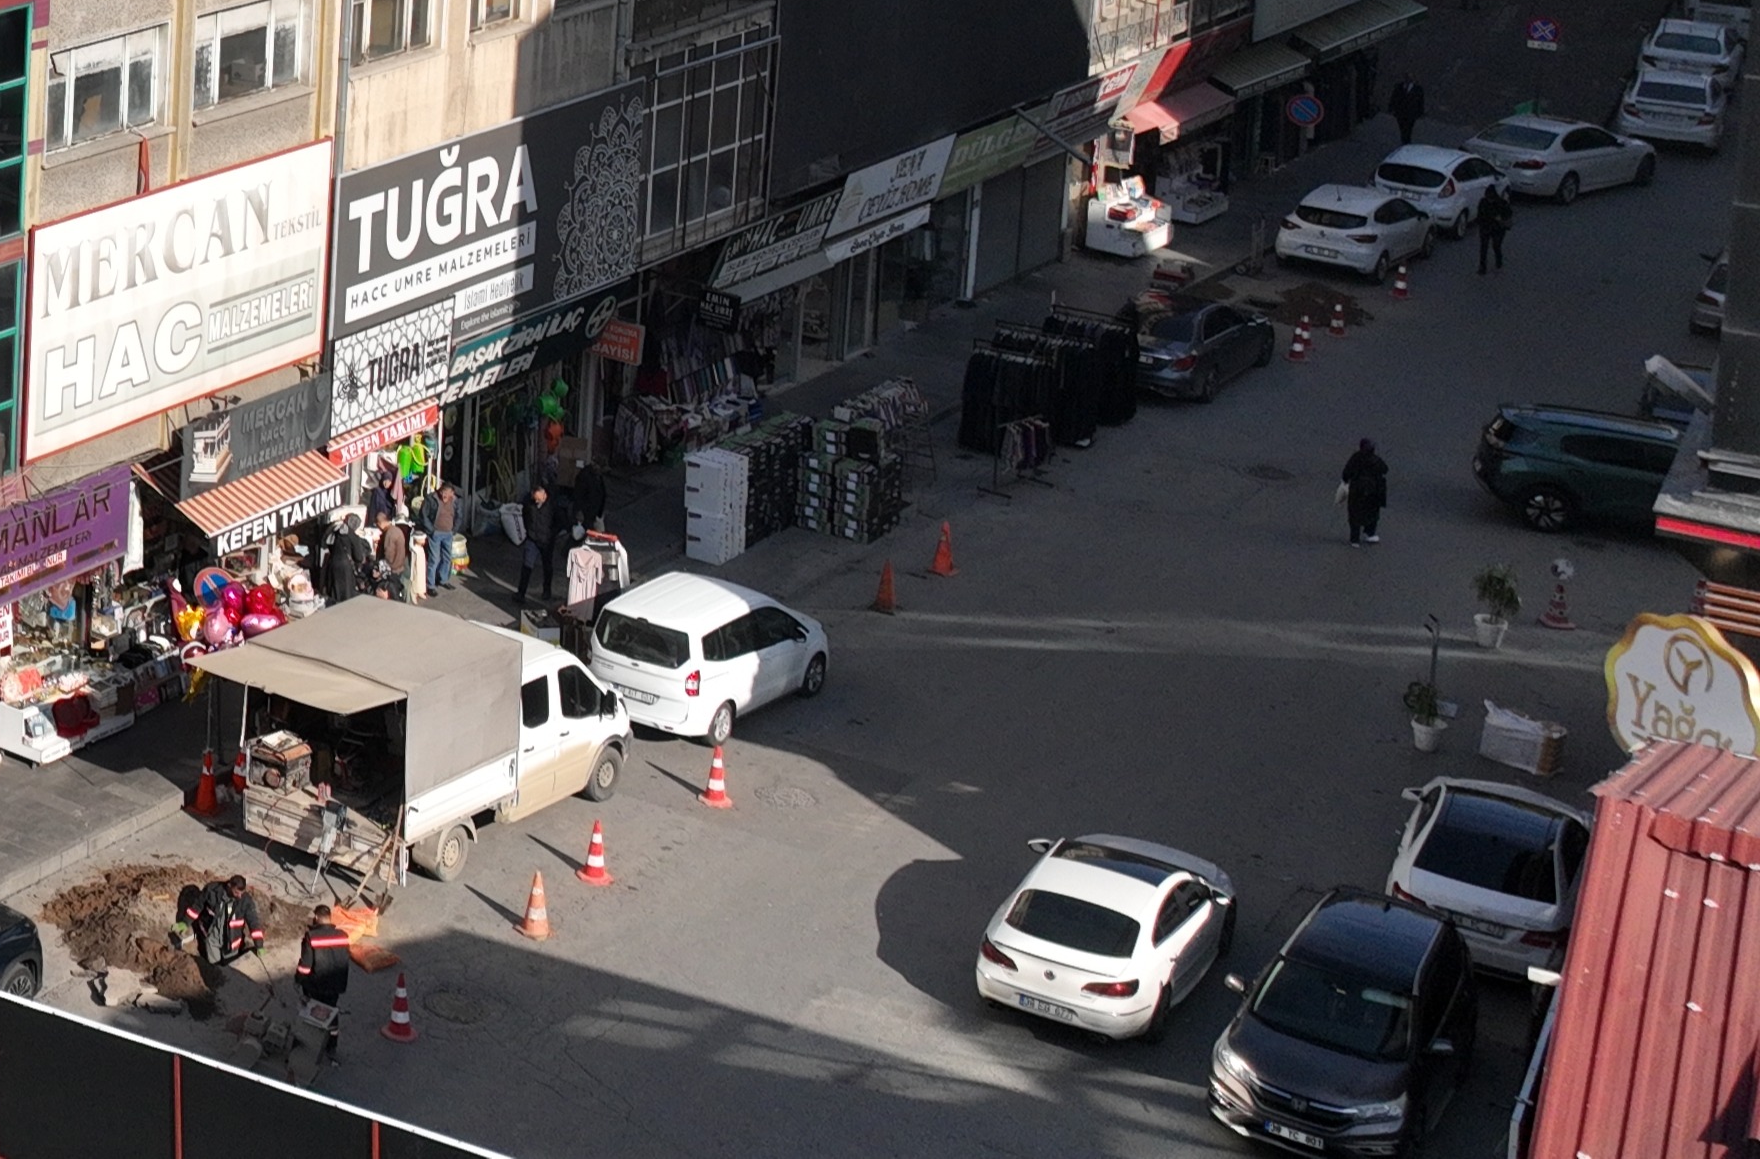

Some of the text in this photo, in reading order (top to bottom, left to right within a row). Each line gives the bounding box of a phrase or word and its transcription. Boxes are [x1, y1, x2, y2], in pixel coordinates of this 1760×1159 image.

[348, 144, 538, 274] TUĞRA
[747, 192, 845, 253] HAC UMRE
[40, 179, 323, 319] MERCAN TEKSTİL
[350, 227, 531, 309] HACC UMRE MALZEMELERİ
[43, 300, 203, 421] HAC
[368, 342, 421, 395] TUĞRA
[449, 336, 509, 378] BAŞAK
[546, 307, 585, 338] İLAÇ
[459, 345, 538, 398] ALETLERİ
[242, 390, 308, 434] MERCAN
[340, 434, 380, 463] KEFEN
[217, 486, 342, 558] KEFEN TAKIMI
